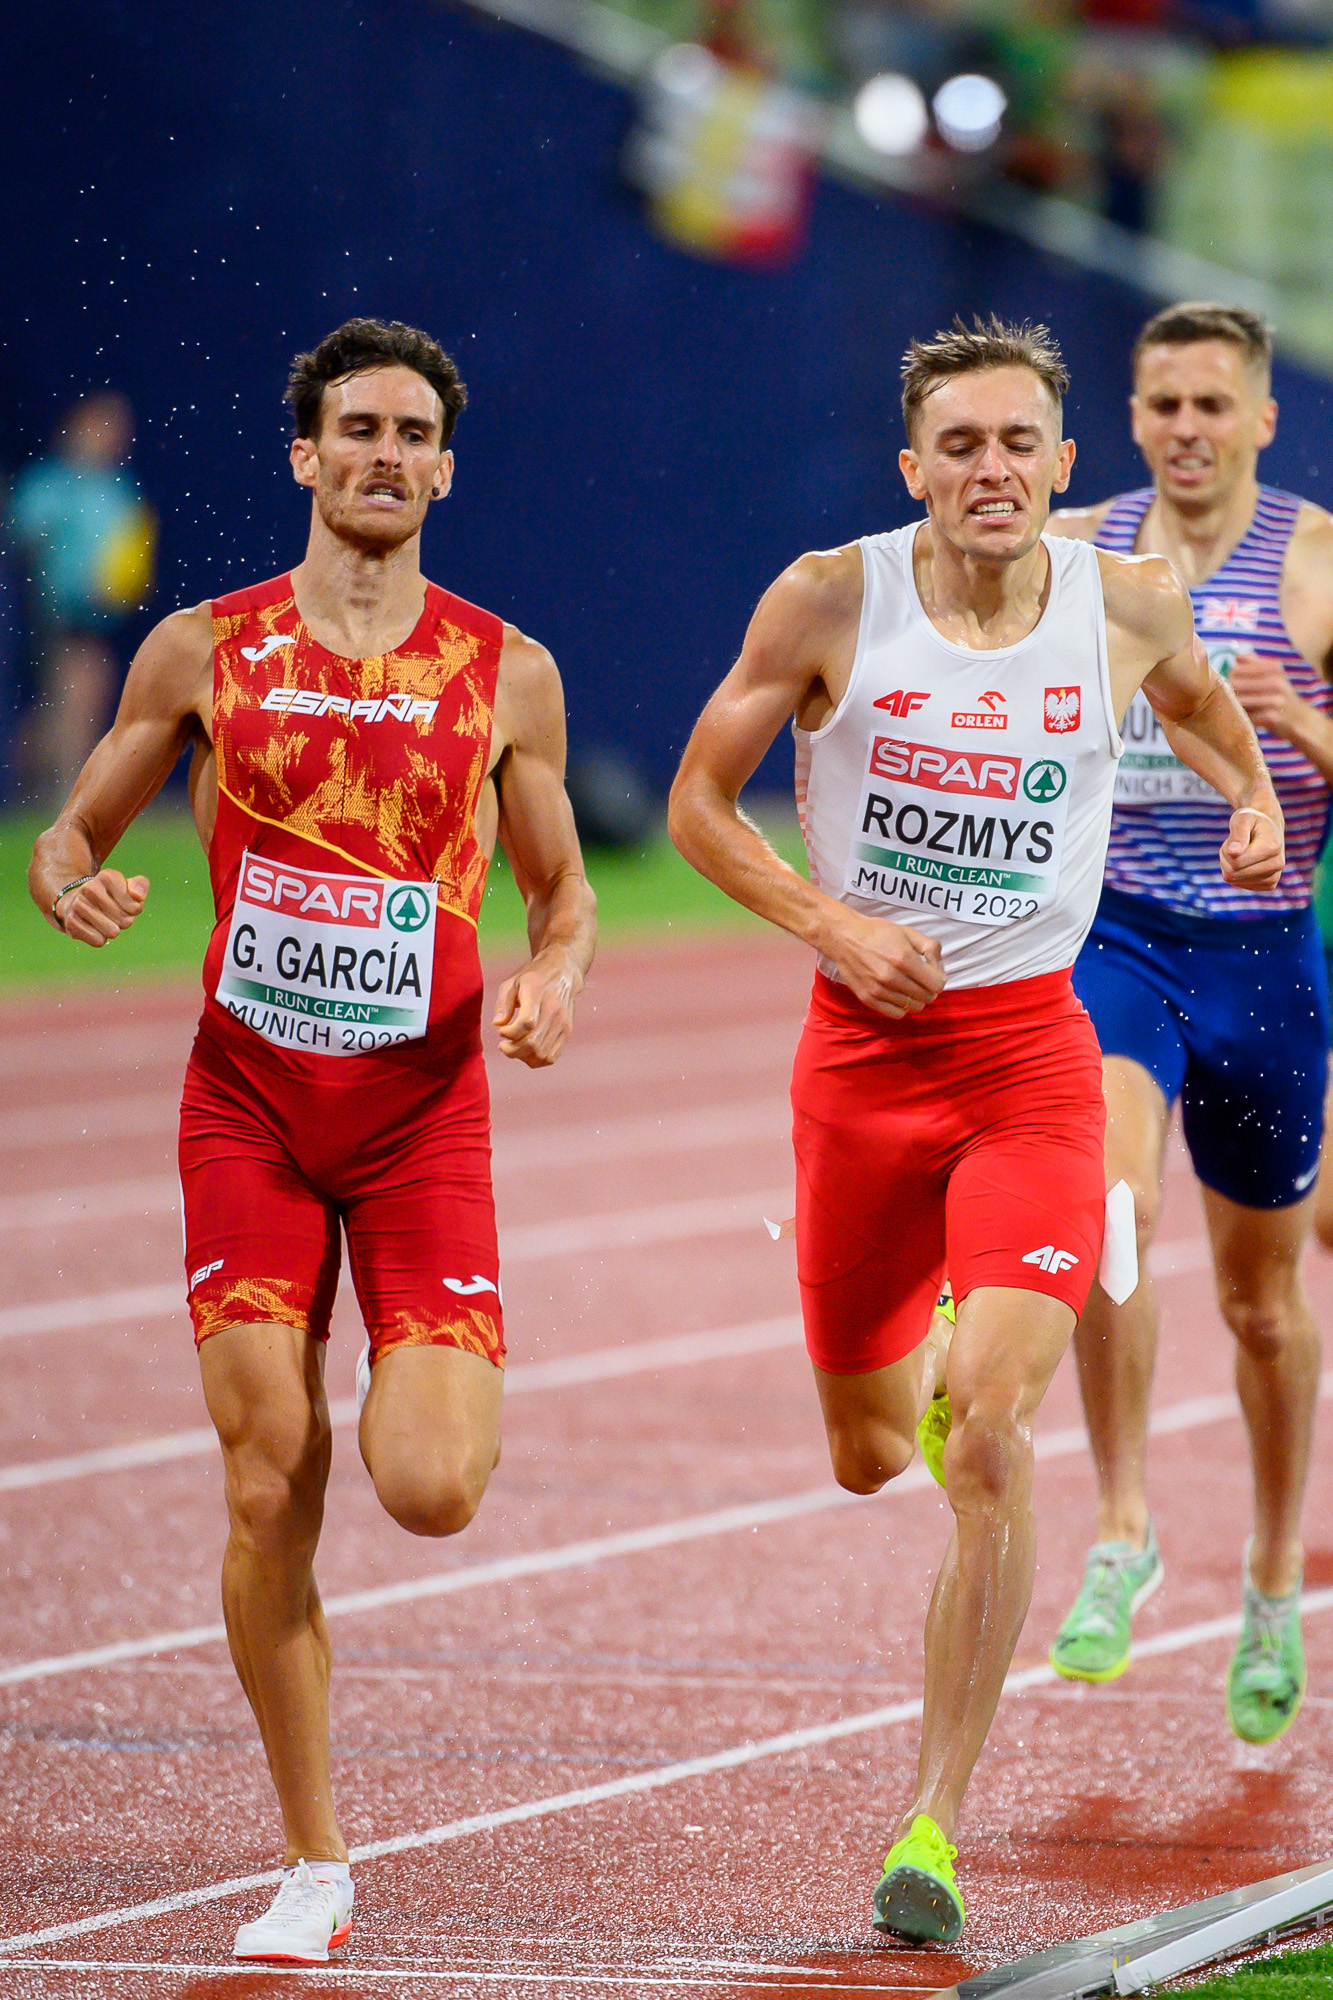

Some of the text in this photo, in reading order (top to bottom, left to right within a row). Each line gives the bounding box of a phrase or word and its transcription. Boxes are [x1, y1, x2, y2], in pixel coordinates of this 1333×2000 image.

[260, 687, 440, 723] ESPAÑA
[873, 689, 931, 718] 4F
[954, 714, 1005, 728] ORLEN
[874, 742, 1016, 794] SPAR
[861, 792, 1055, 864] ROZMYS
[895, 854, 901, 868] I
[905, 857, 943, 878] RUN
[244, 865, 379, 921] SPAR
[856, 867, 1038, 919] MUNICH 2022
[232, 924, 422, 998] G. GARCÍA
[266, 988, 270, 1001] I
[274, 991, 309, 1012] RUN
[227, 1000, 330, 1048] MUNICH
[1021, 1245, 1080, 1275] 4F
